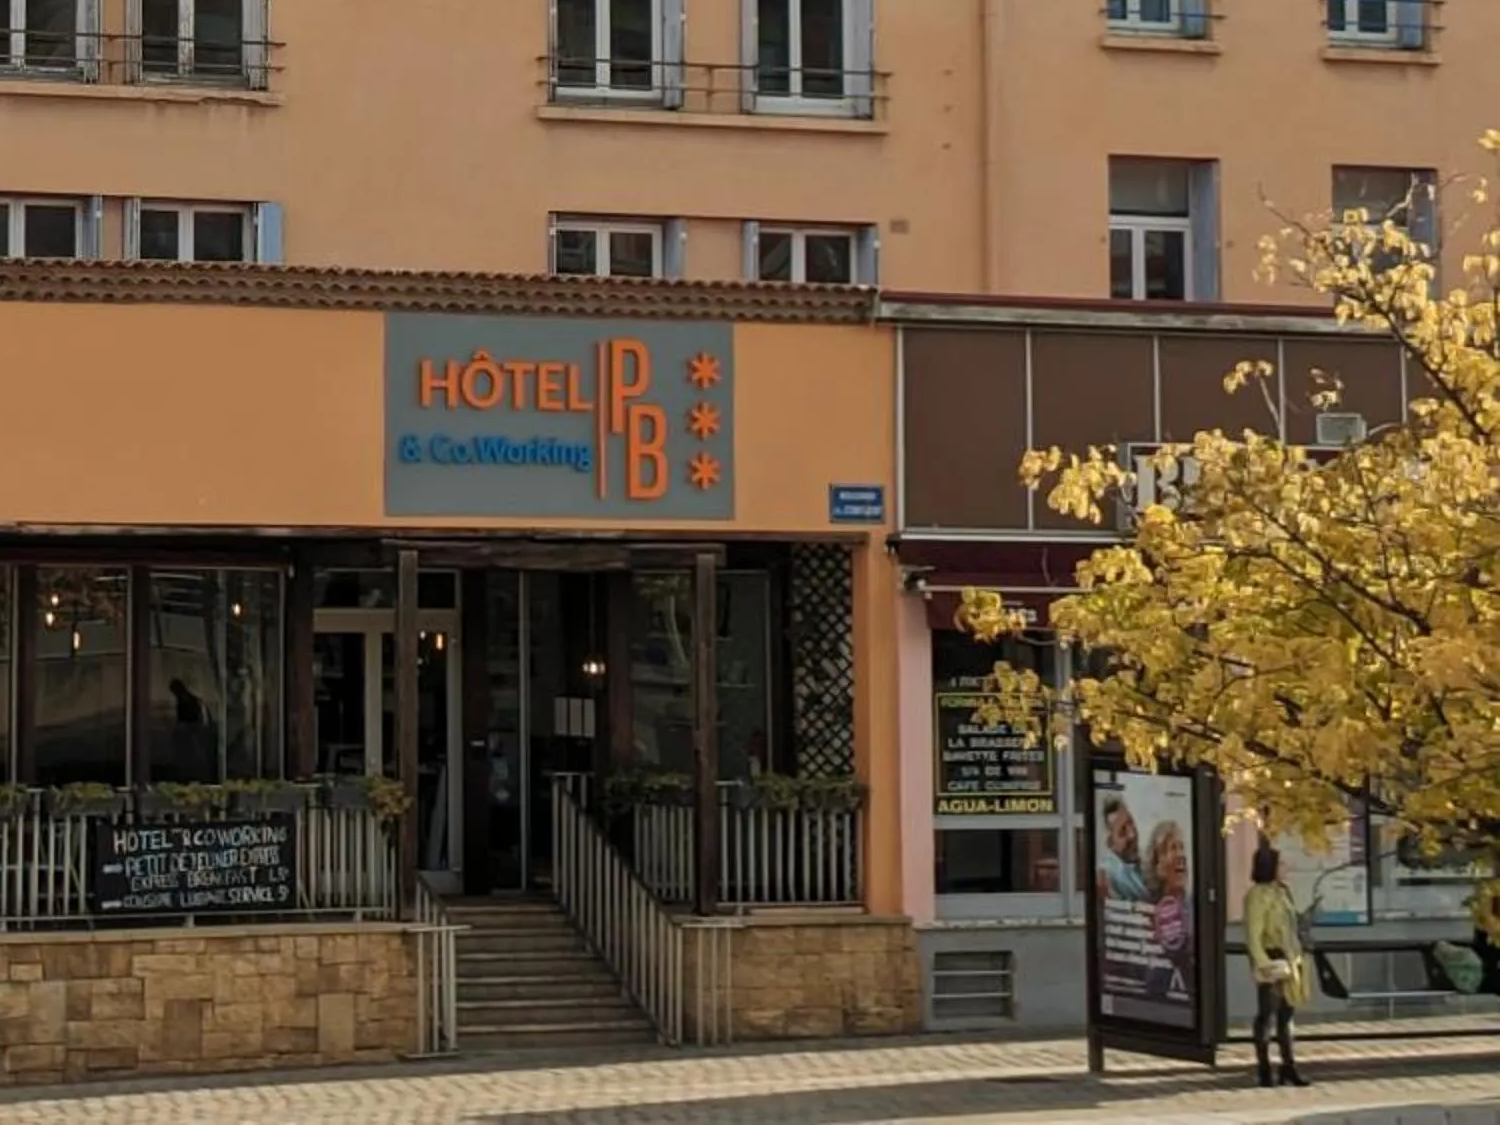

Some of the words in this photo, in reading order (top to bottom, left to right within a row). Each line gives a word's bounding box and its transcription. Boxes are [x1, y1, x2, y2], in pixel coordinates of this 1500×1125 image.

[419, 349, 594, 412] HÔTEL
[399, 435, 421, 464] &
[938, 798, 1053, 813] AGUA-LIMON
[113, 830, 174, 854] HOTEL
[193, 826, 288, 847] COWORKING
